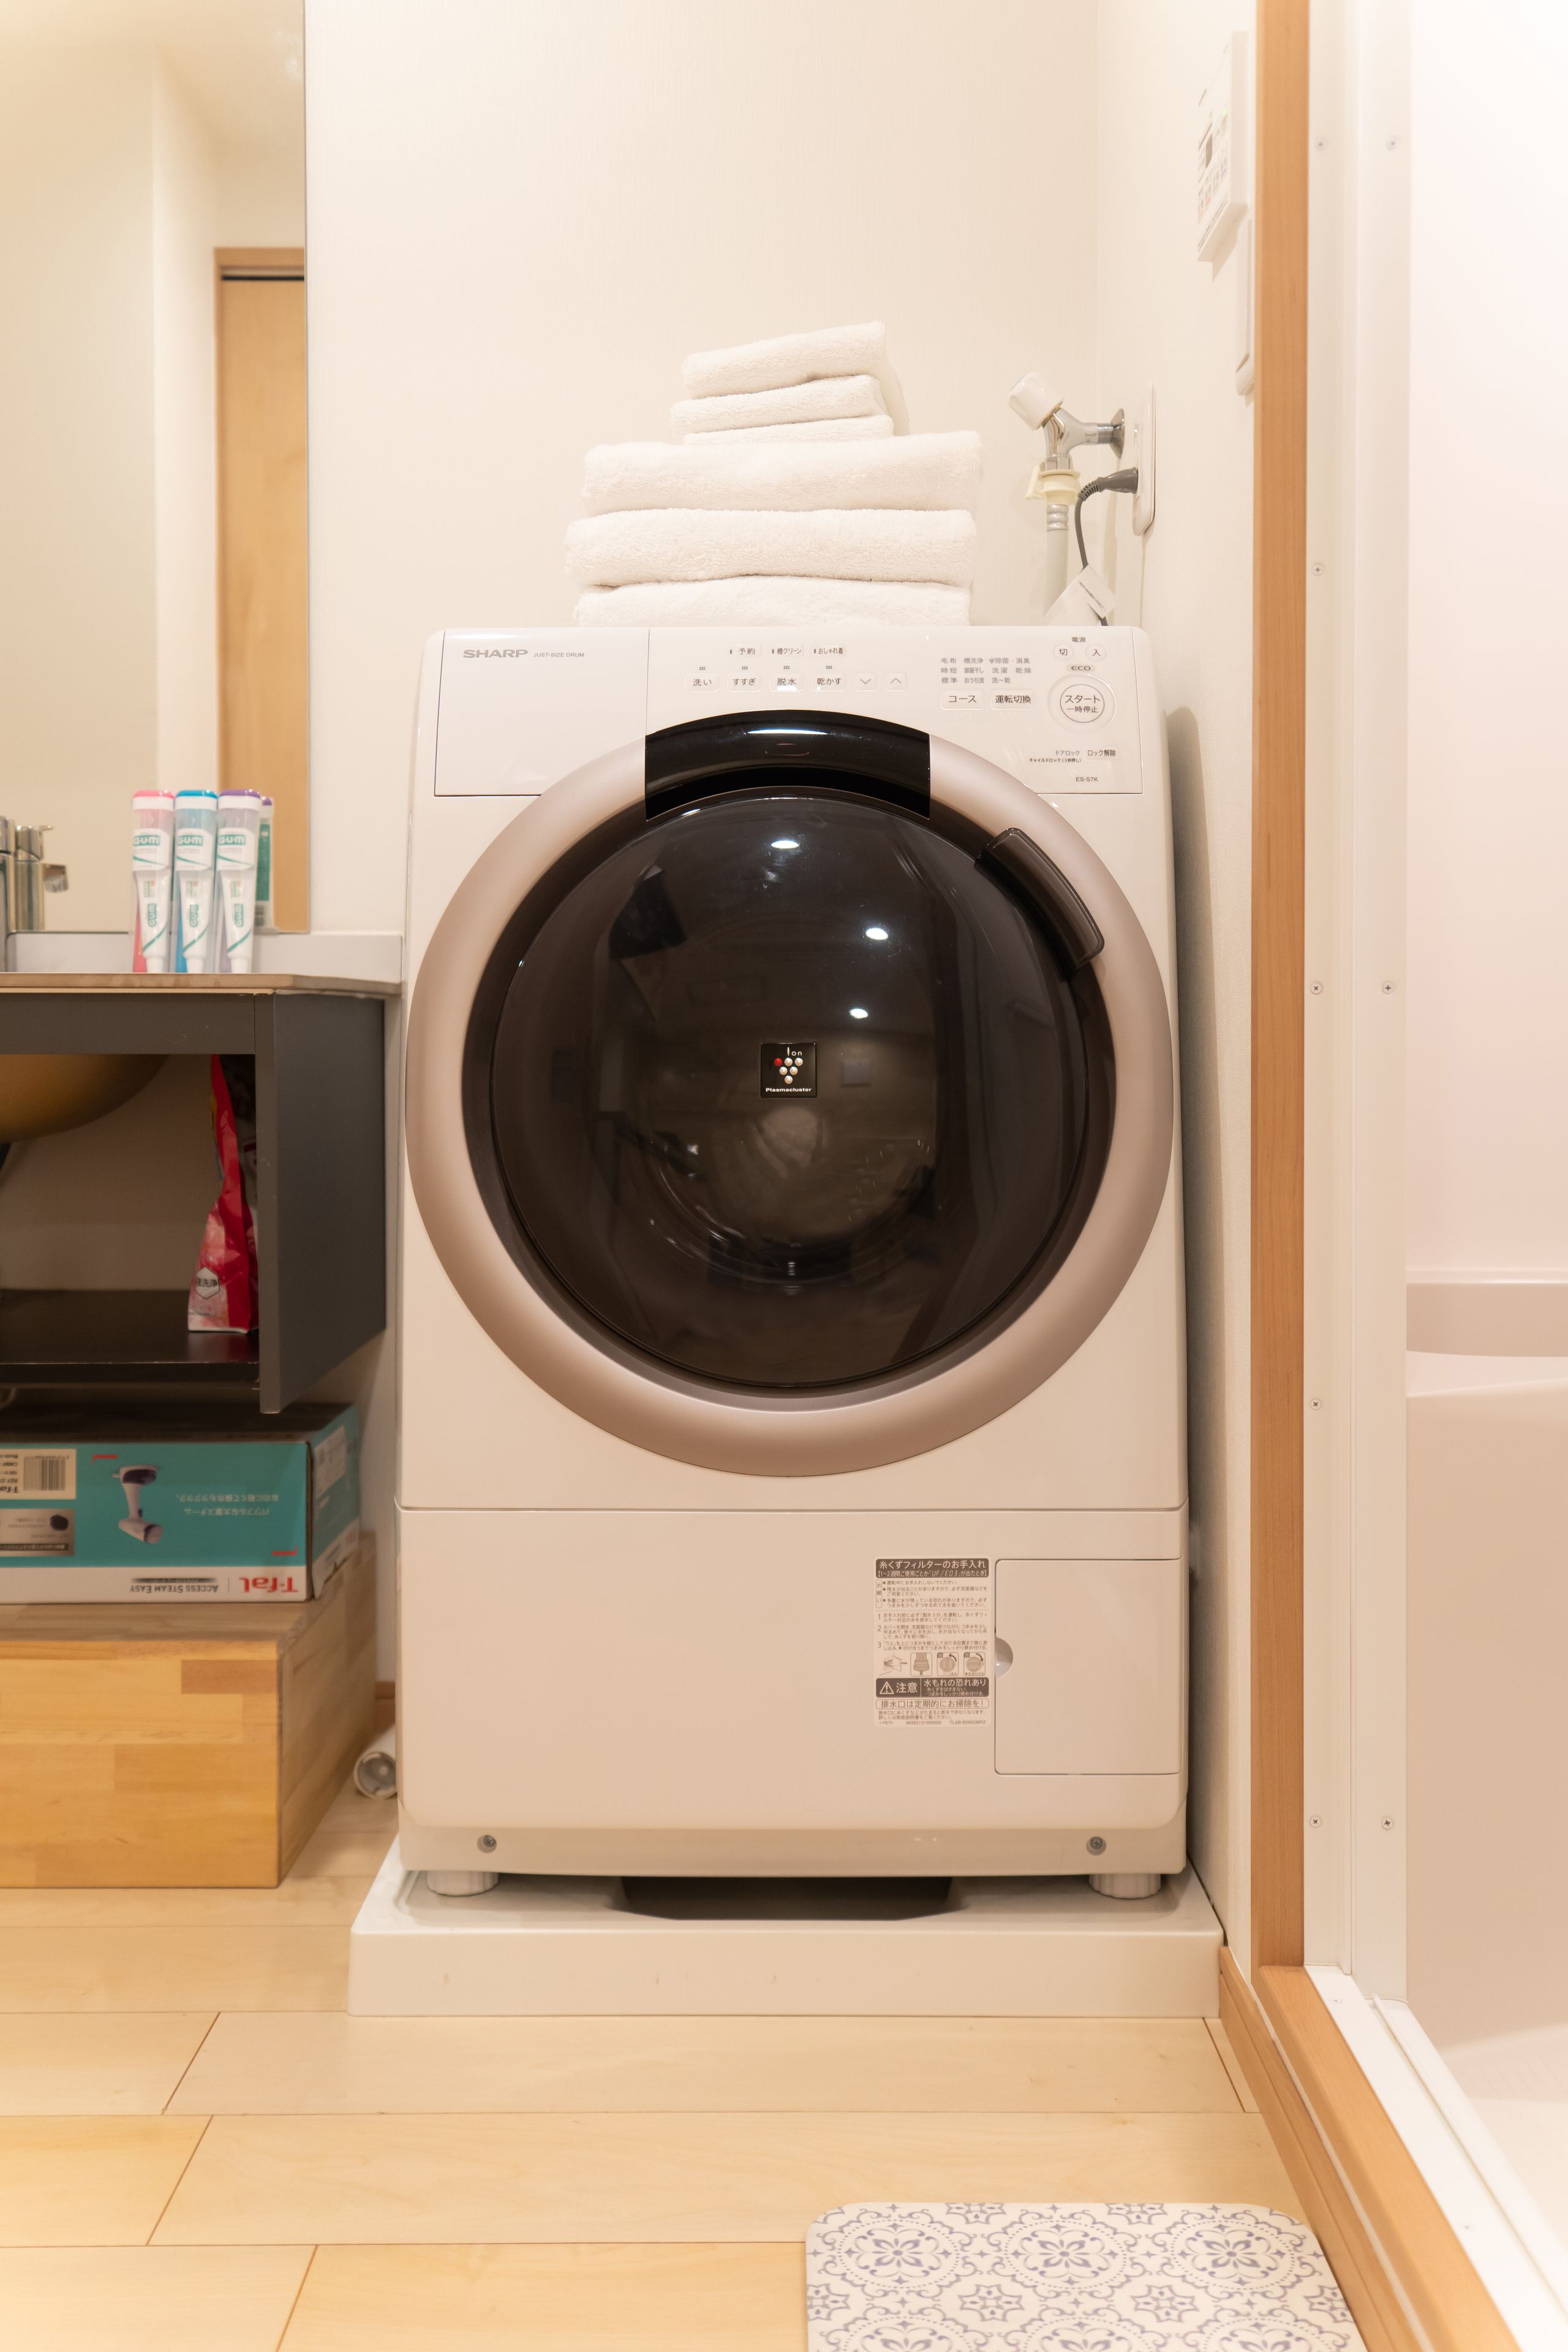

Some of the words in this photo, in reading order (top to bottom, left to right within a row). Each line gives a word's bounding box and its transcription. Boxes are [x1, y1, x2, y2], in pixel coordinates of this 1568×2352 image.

[462, 649, 528, 658] SHARP
[693, 678, 712, 687] 洗い
[777, 677, 796, 686] 脱水
[995, 695, 1031, 704] 運転切換
[1064, 695, 1101, 704] スタート
[879, 1560, 986, 1569] 糸くずフィルターのお手入れ
[239, 1577, 298, 1593] T-fal
[896, 1683, 918, 1694] 注意
